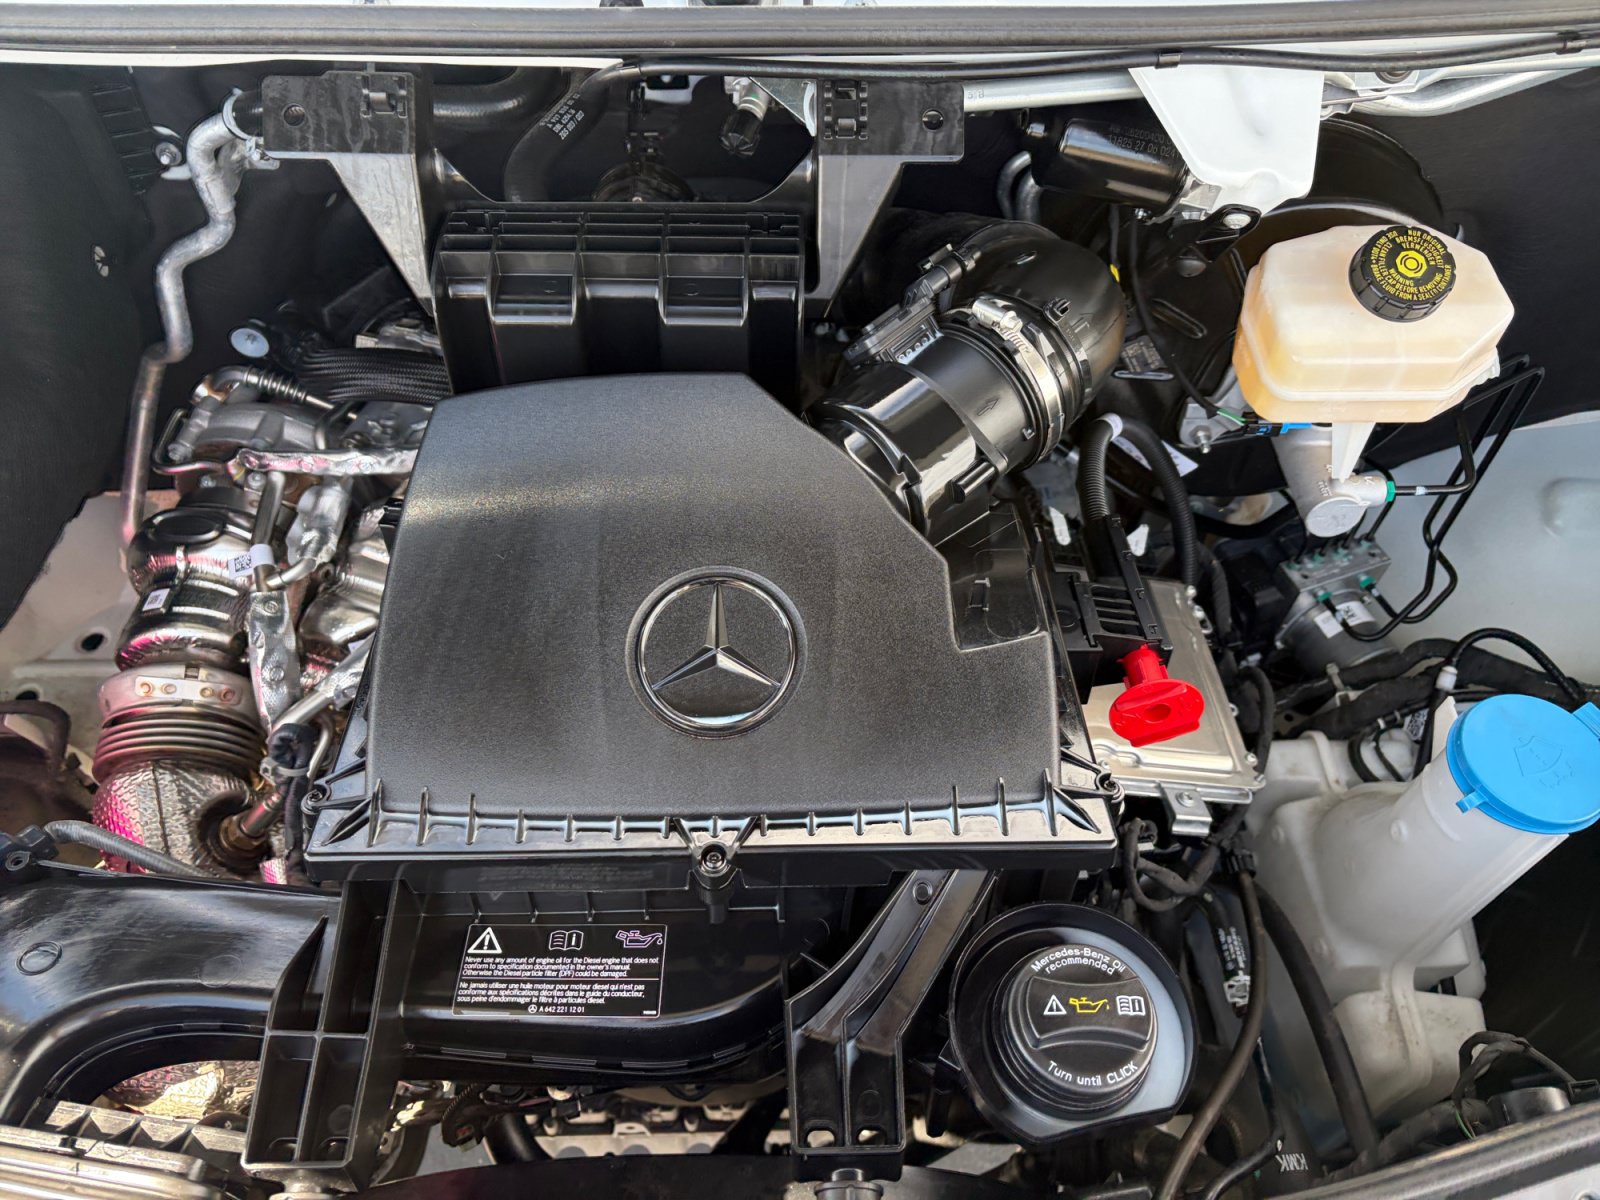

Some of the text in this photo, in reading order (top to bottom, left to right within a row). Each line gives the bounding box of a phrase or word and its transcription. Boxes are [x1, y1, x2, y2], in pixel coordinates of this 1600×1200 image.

[1376, 236, 1388, 249] ONLY
[1386, 230, 1398, 239] USE
[1422, 233, 1446, 255] ORIGINAL
[1402, 242, 1436, 265] VERWENDEN
[1371, 264, 1384, 282] BRAKE
[1378, 242, 1442, 294] CLEAN FILLER CAP BEFORE REMOVING
[1389, 268, 1414, 286] WARNING
[1380, 280, 1396, 294] FLUID
[1436, 264, 1451, 292] CONTAINER
[1396, 291, 1412, 300] FROM
[1418, 288, 1438, 300] SEALED
[1031, 948, 1126, 973] Mercedes-Benz Oil
[1045, 956, 1115, 976] recommended
[488, 996, 531, 1004] d'endommager
[1048, 1060, 1138, 1086] Turn until CLICK
[1275, 1153, 1308, 1172] KMK
